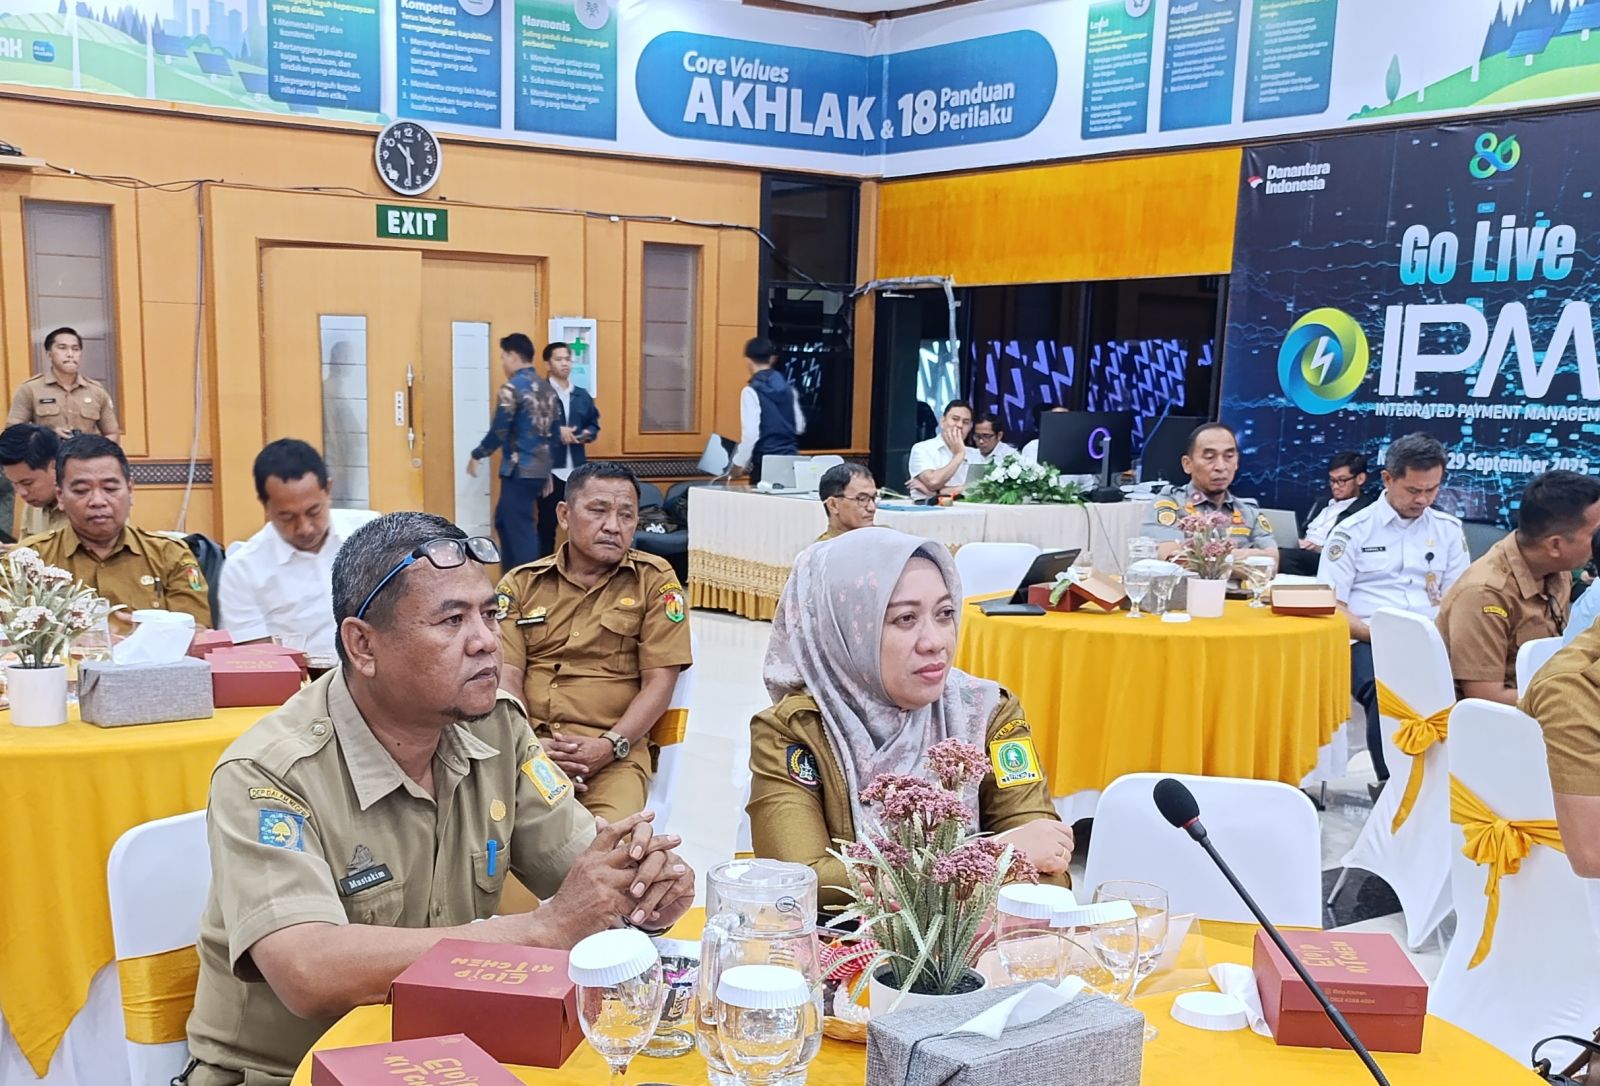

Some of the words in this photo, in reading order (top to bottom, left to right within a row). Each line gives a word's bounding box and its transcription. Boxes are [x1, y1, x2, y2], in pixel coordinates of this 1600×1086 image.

[401, 0, 457, 16] Kompeten
[522, 14, 571, 32] Harmonis
[682, 50, 725, 76] Core
[730, 56, 790, 84] Values
[940, 82, 1015, 109] Panduan
[682, 77, 877, 141] AKHLAK
[880, 119, 895, 140] &
[897, 89, 938, 138] 18
[939, 104, 1013, 132] Perilaku
[404, 128, 414, 137] 12
[384, 138, 396, 147] 10
[424, 142, 431, 152] 2
[382, 150, 390, 160] 9
[426, 155, 433, 164] 3
[1267, 161, 1331, 180] Danantara
[1265, 176, 1326, 195] Indonesia
[387, 209, 438, 236] EXIT
[1400, 224, 1459, 286] Go
[1471, 214, 1576, 283] Live
[1378, 301, 1600, 400] IPM
[1375, 402, 1457, 418] INTEGRATED
[1457, 404, 1522, 420] PAYMENT
[1446, 453, 1465, 470] 29
[1467, 453, 1549, 475] September
[348, 871, 386, 889] Mustakim
[451, 957, 555, 973] KITCHEN
